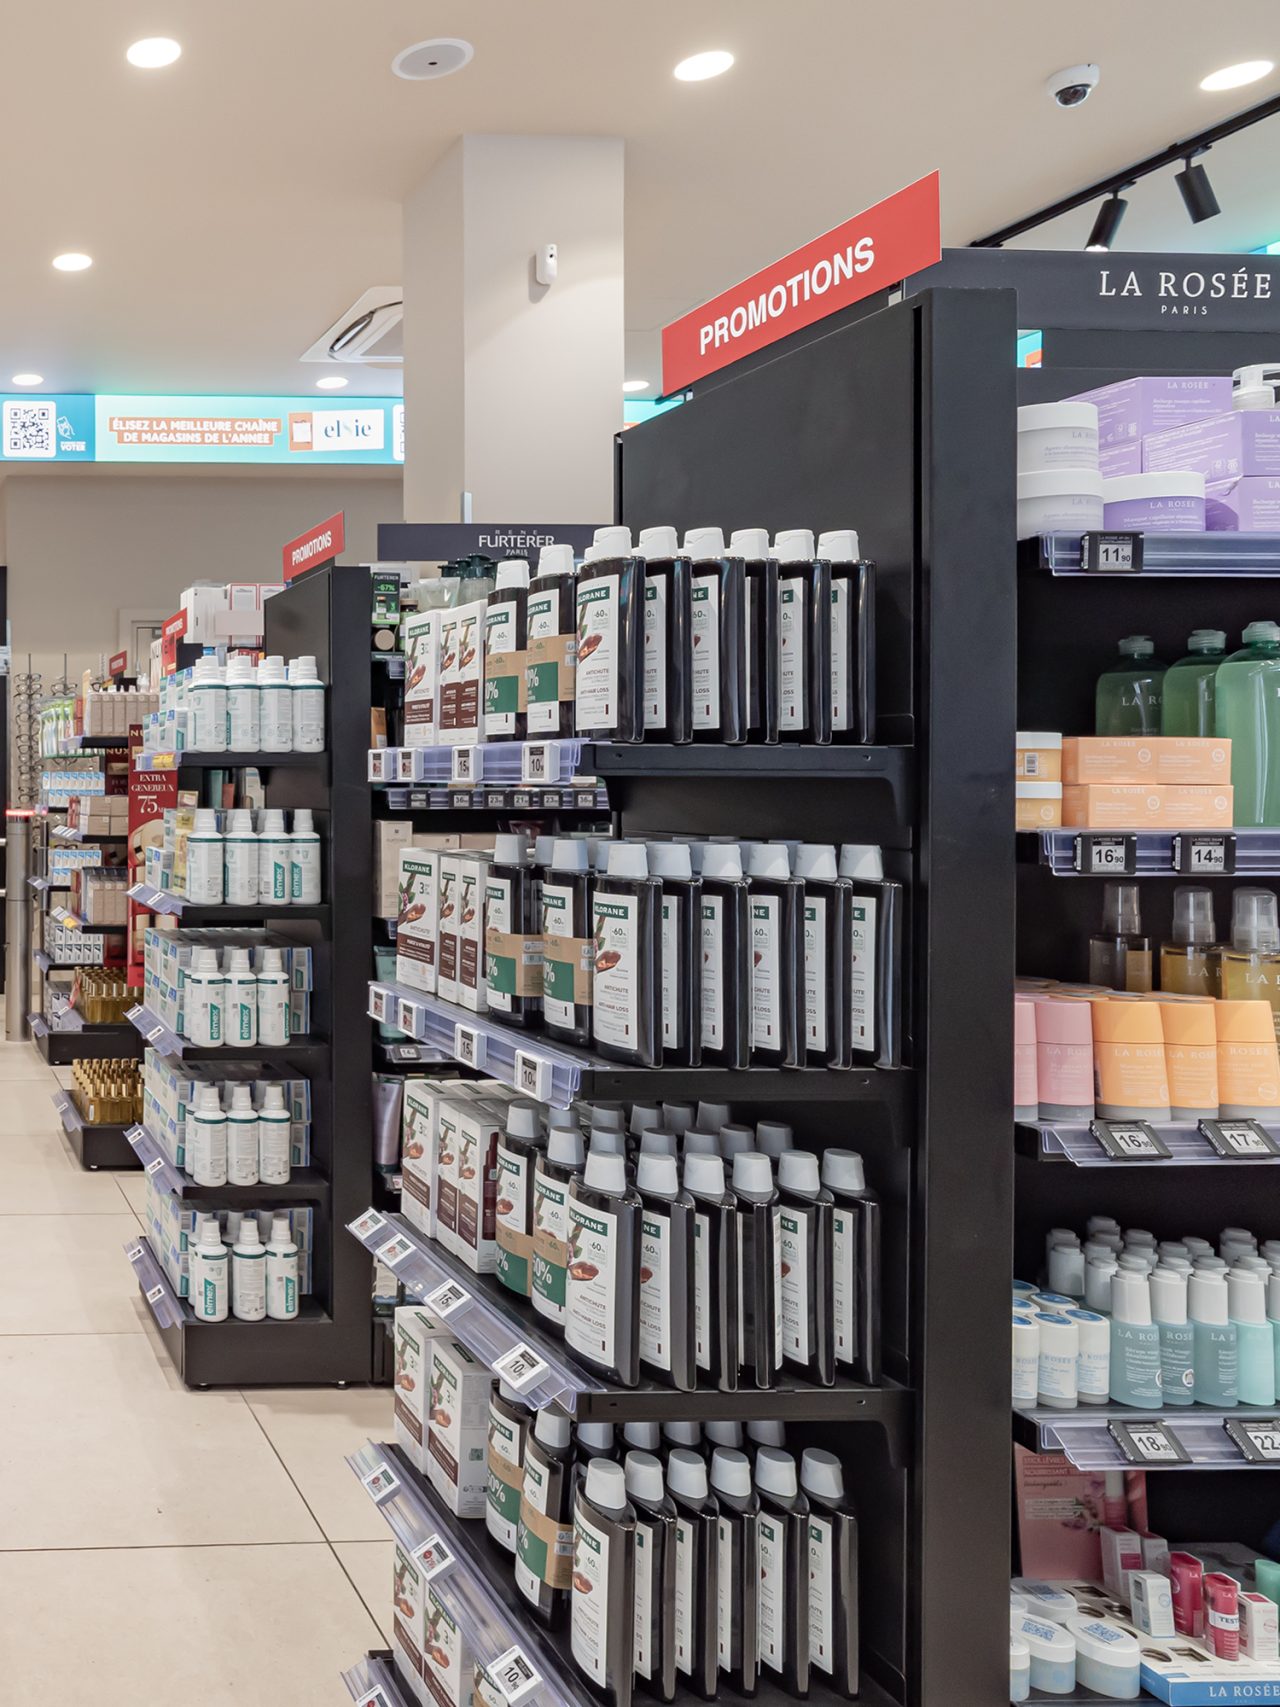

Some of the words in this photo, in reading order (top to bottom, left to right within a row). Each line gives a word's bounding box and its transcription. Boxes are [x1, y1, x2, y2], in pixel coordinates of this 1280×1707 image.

[1099, 270, 1142, 298] LA
[1158, 267, 1272, 299] ROSÉE
[699, 236, 875, 356] PROMOTIONS
[1161, 305, 1209, 316] PARIS
[112, 417, 150, 431] ÉLISEZ
[153, 420, 168, 431] LA
[171, 420, 232, 432] MEILLEURE
[235, 418, 278, 433] CHAÎNE
[123, 433, 138, 443] DE
[141, 433, 201, 443] MAGASINS
[204, 433, 219, 443] DE
[292, 531, 332, 565] PROMOTIONS
[478, 535, 555, 548] FURTERER
[139, 774, 167, 782] EXTRA
[138, 795, 158, 813] 75
[404, 863, 430, 874] KLORANE
[1246, 973, 1269, 984] LA
[211, 1009, 219, 1039] elmex
[241, 1009, 249, 1039] elmex
[206, 1284, 214, 1314] elmex
[1210, 1686, 1227, 1697] LA
[1233, 1683, 1280, 1698] ROSÉE
